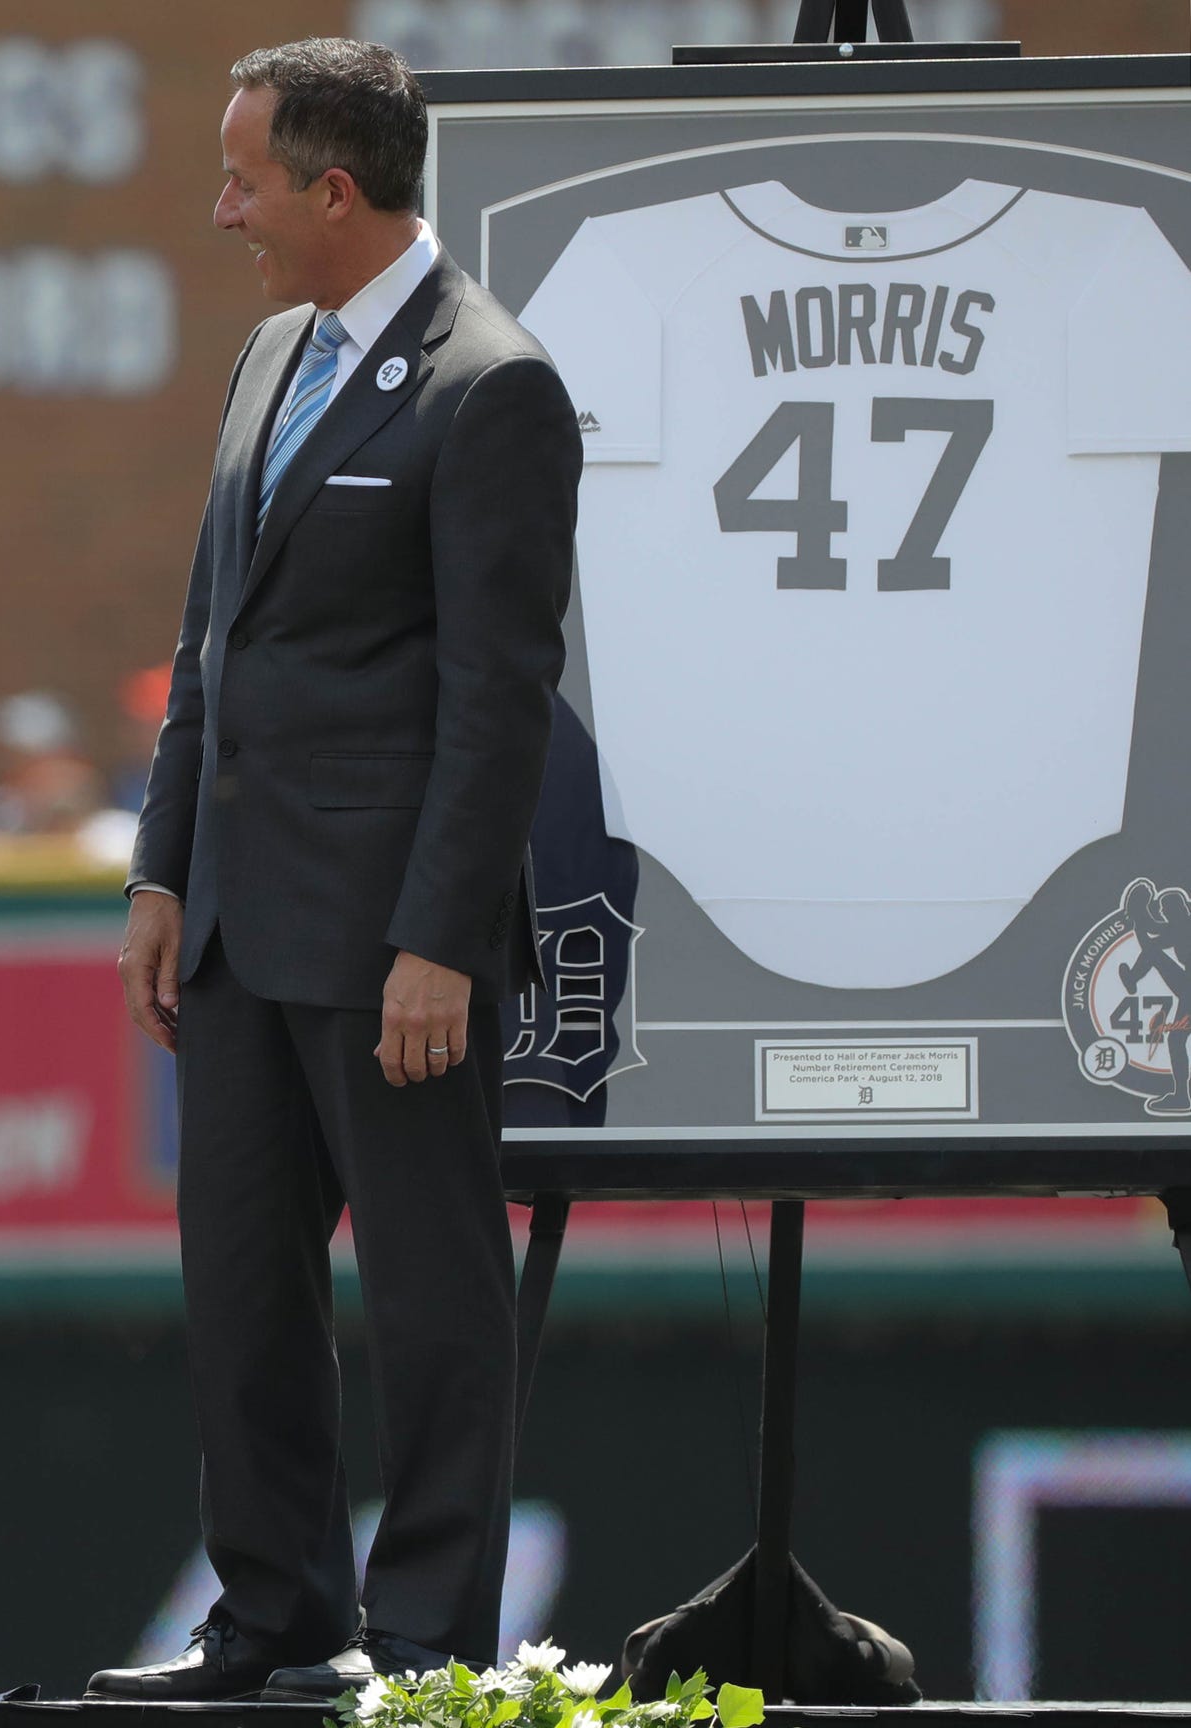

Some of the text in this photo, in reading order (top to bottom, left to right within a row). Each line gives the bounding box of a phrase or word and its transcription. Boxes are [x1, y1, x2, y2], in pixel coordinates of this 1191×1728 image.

[739, 281, 997, 379] MORRIS
[382, 363, 403, 384] 47
[712, 396, 995, 592] 47
[1072, 919, 1126, 1011] JACK MORRIS
[1109, 995, 1174, 1044] 47
[772, 1051, 959, 1062] Presented to Hall of Famer Jack Morris
[792, 1063, 939, 1073] Number Retirement Ceremony
[789, 1074, 835, 1083] Comerica
[837, 1074, 859, 1082] Park
[868, 1074, 902, 1083] August
[905, 1074, 917, 1083] 12,
[920, 1073, 943, 1082] 2018
